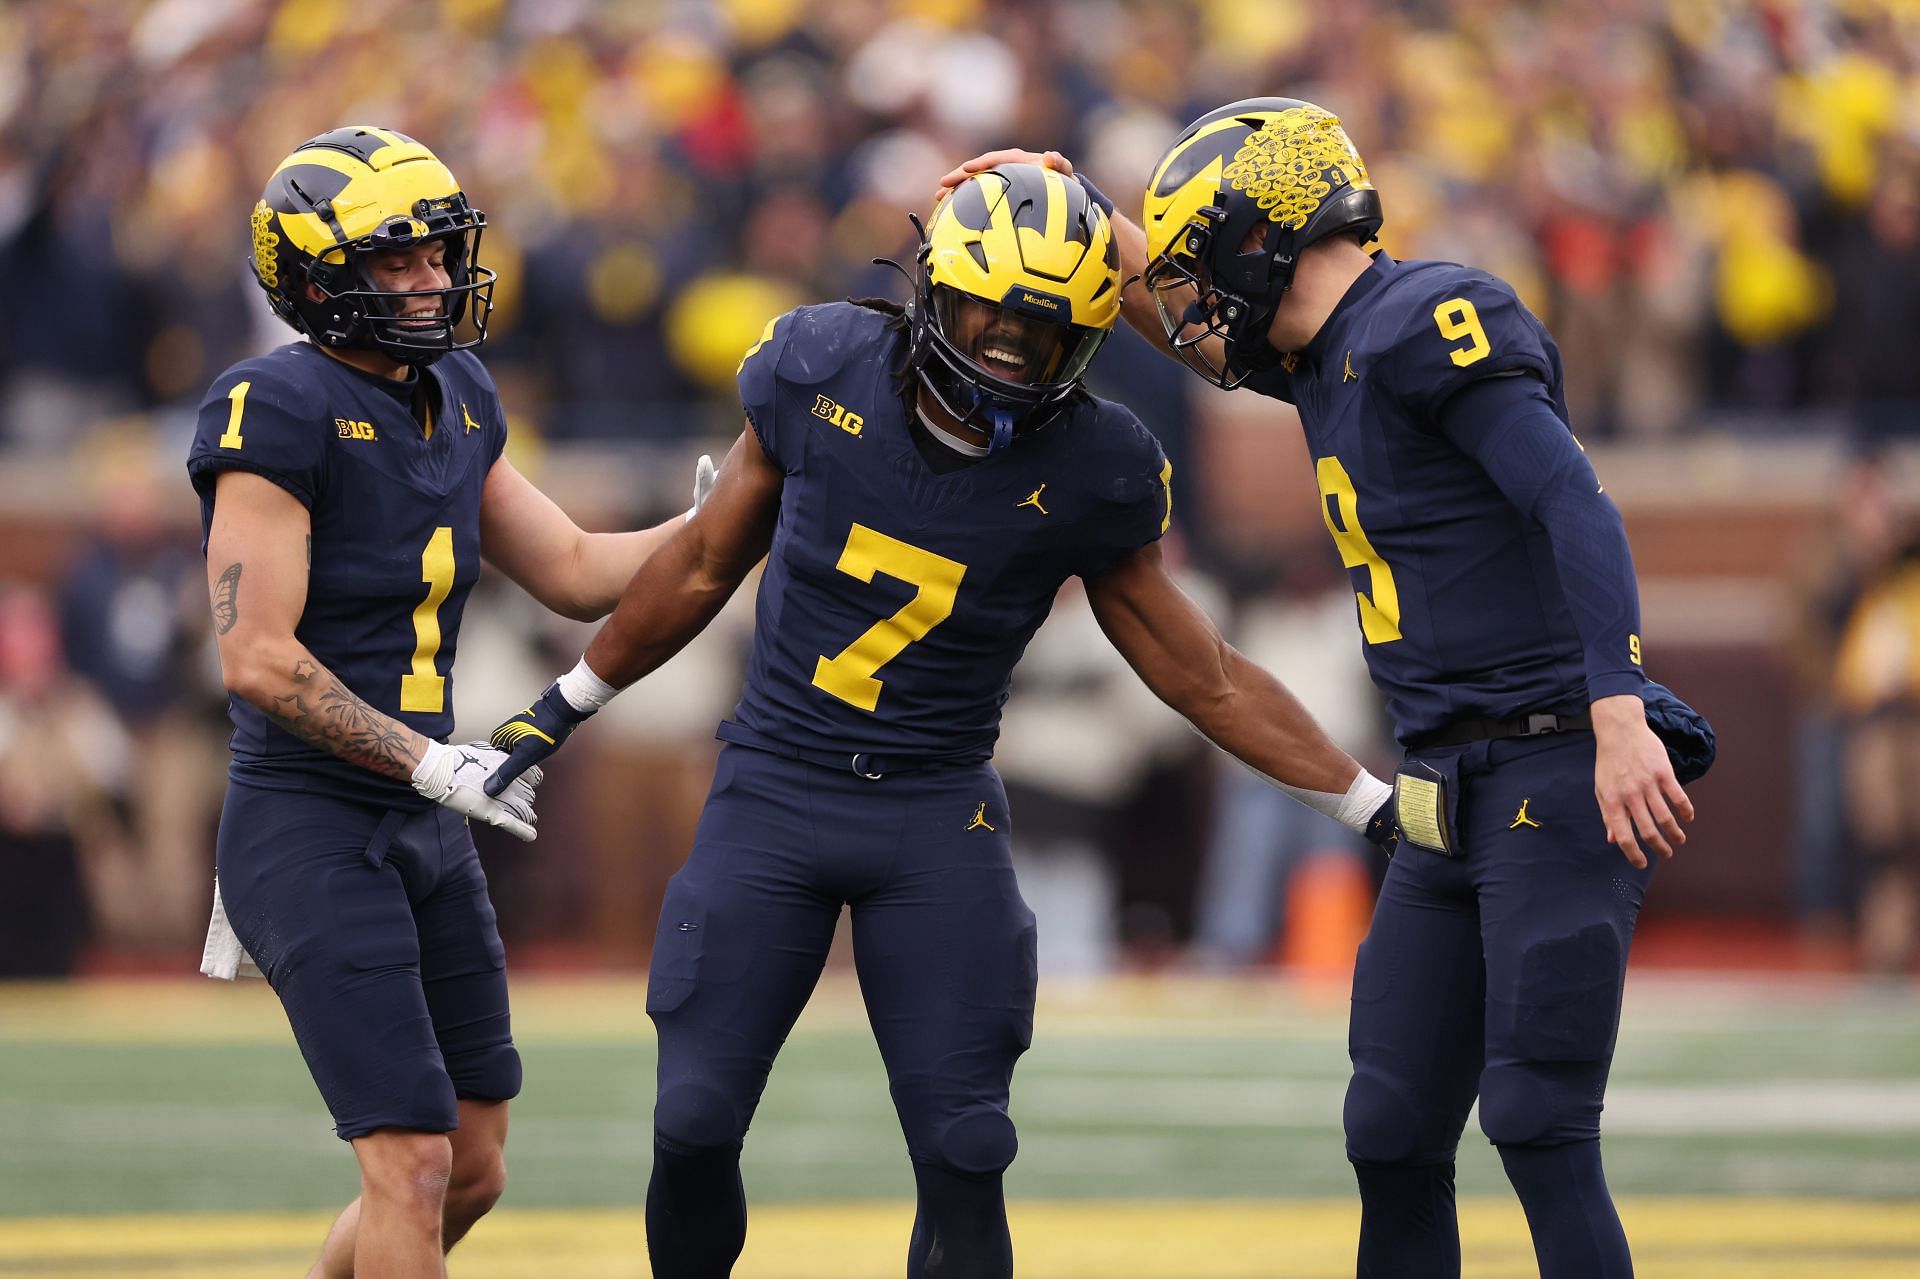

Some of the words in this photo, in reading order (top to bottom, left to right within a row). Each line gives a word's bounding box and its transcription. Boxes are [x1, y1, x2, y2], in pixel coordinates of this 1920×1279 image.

[1331, 170, 1342, 185] 9
[1433, 298, 1491, 368] 9
[219, 382, 250, 450] 1
[1316, 456, 1403, 645] 9
[400, 527, 456, 713] 1
[812, 522, 967, 712] 7
[1629, 633, 1642, 665] 9
